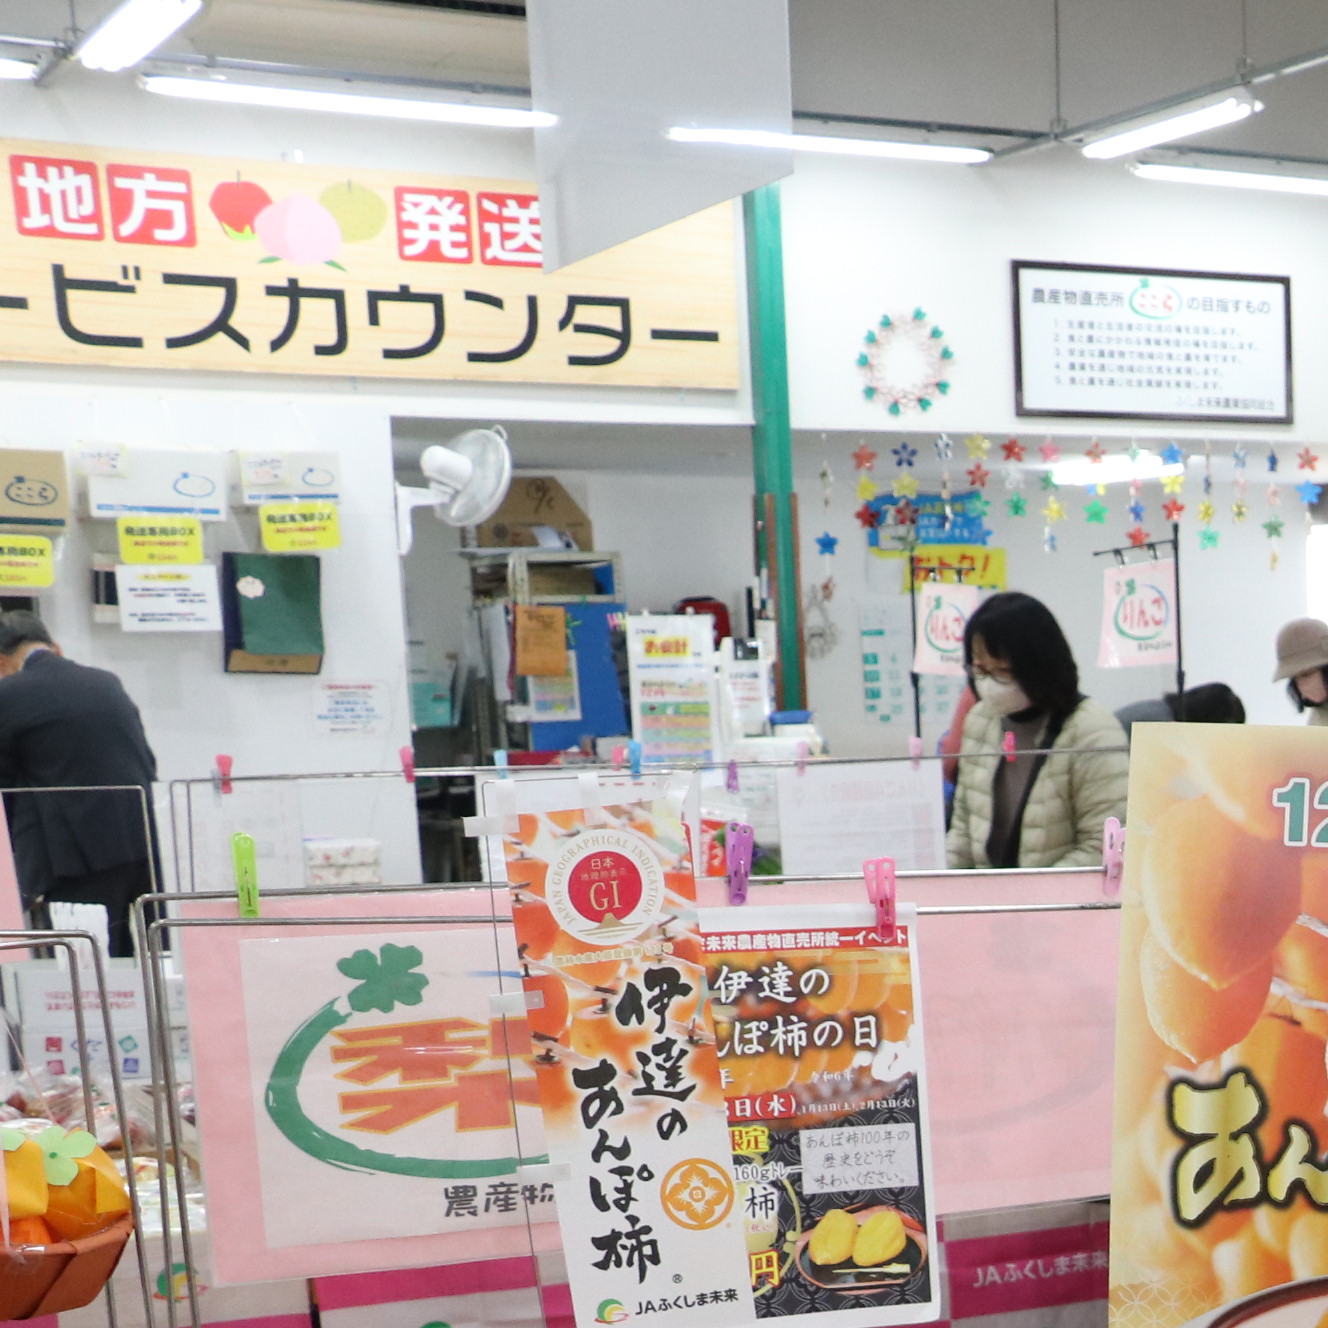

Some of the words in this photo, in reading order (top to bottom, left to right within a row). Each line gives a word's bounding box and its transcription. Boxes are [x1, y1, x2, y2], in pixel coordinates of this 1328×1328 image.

[14, 163, 193, 243] 地方
[399, 191, 543, 264] 発送
[1186, 295, 1271, 316] の目指すもの
[552, 835, 629, 886] GEOGRAPHICAL
[631, 845, 659, 917] INDICATION
[591, 857, 615, 870] 日本
[589, 880, 622, 911] GI
[713, 961, 831, 1004] 伊達の
[615, 966, 698, 1141] 伊達の
[571, 1059, 662, 1285] あんぽ柿
[745, 1185, 777, 1221] 柿
[750, 1250, 783, 1288] 円
[634, 1289, 739, 1316] JAふくしま未来
